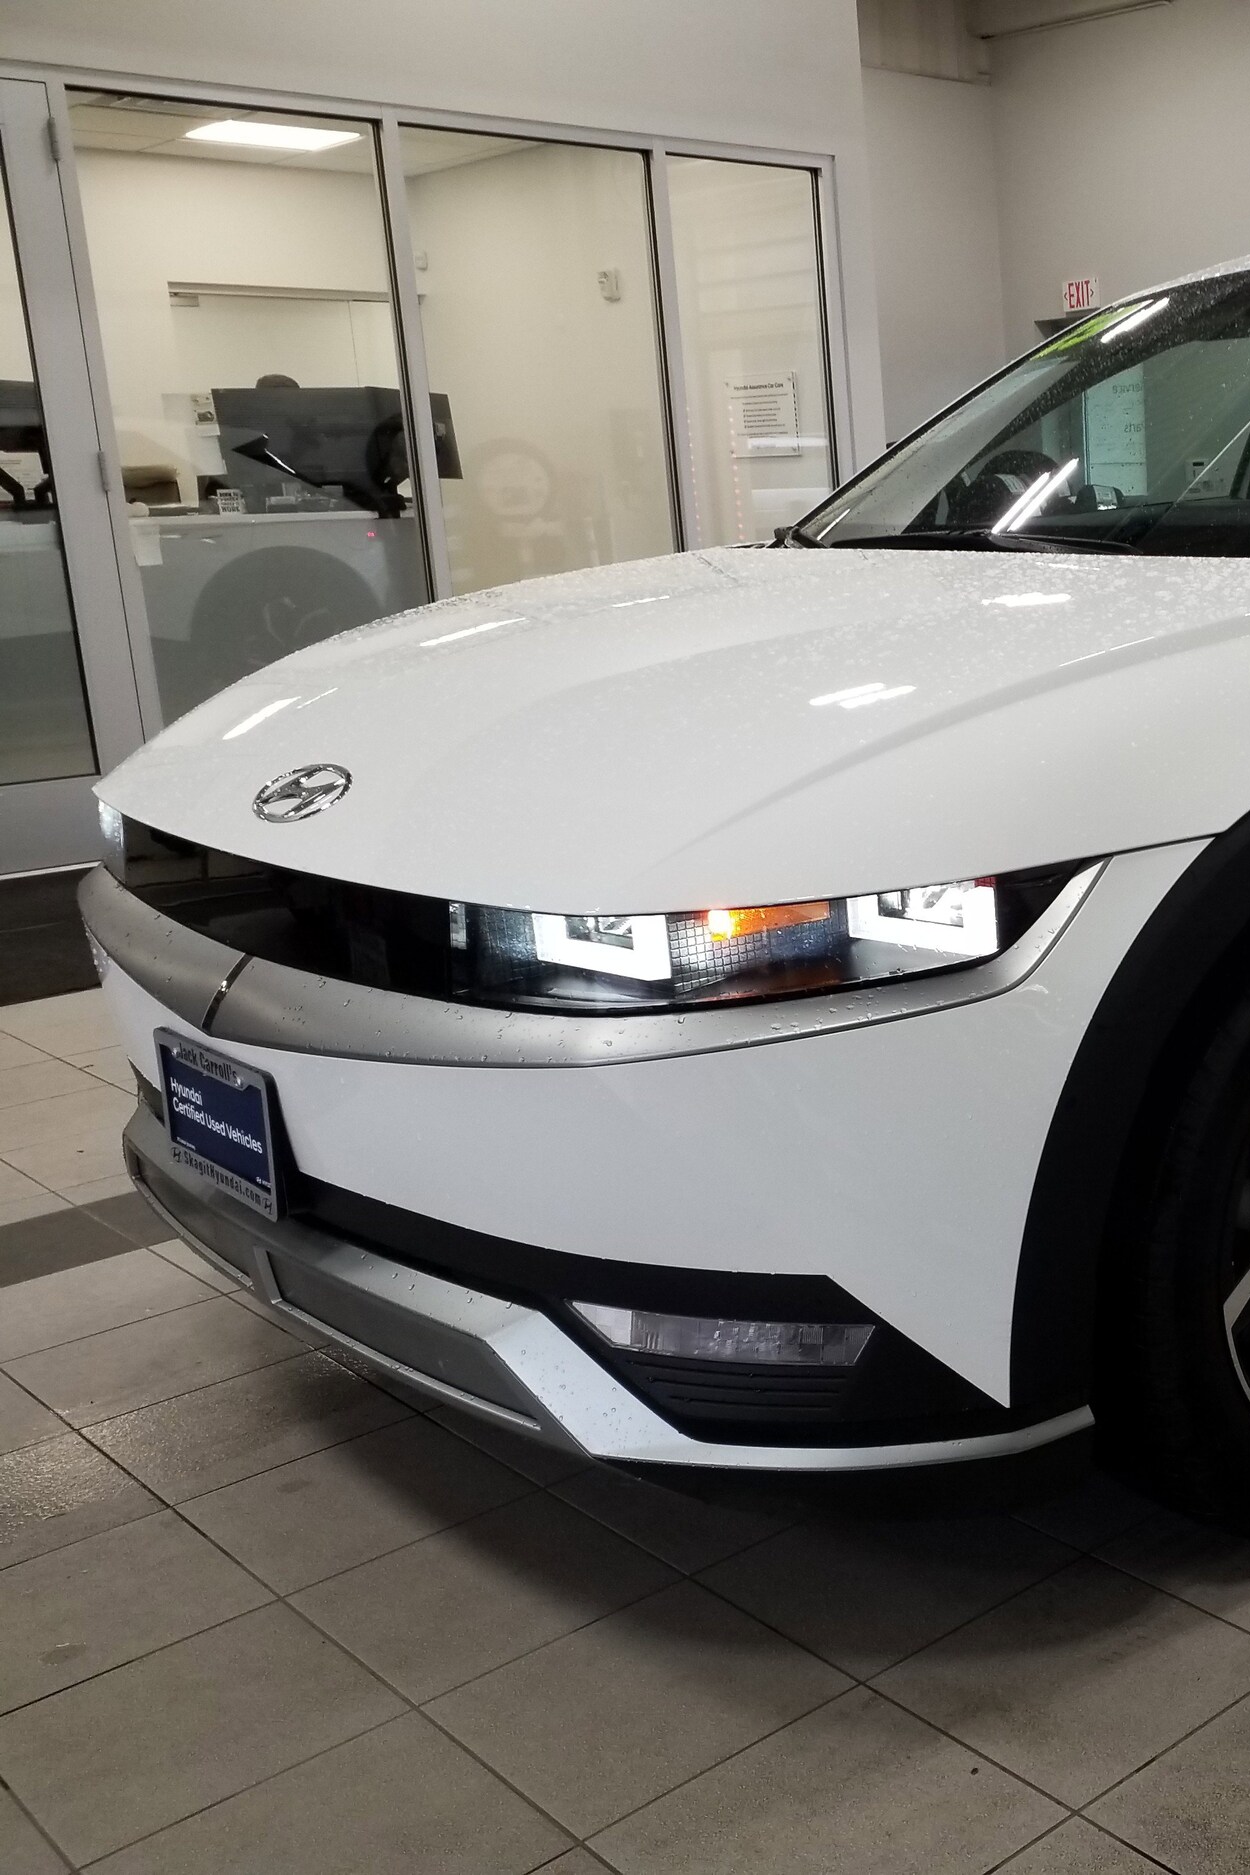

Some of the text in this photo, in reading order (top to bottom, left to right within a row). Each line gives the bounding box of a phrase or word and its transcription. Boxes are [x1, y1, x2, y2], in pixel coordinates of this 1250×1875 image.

[1068, 280, 1090, 308] EXIT
[178, 1042, 199, 1066] Jack
[170, 1077, 203, 1106] Hyundai
[173, 1096, 206, 1126] Certified
[205, 1113, 226, 1137] Used
[226, 1123, 263, 1155] Vehicles
[183, 1151, 261, 1206] SkagitHyundai.com
